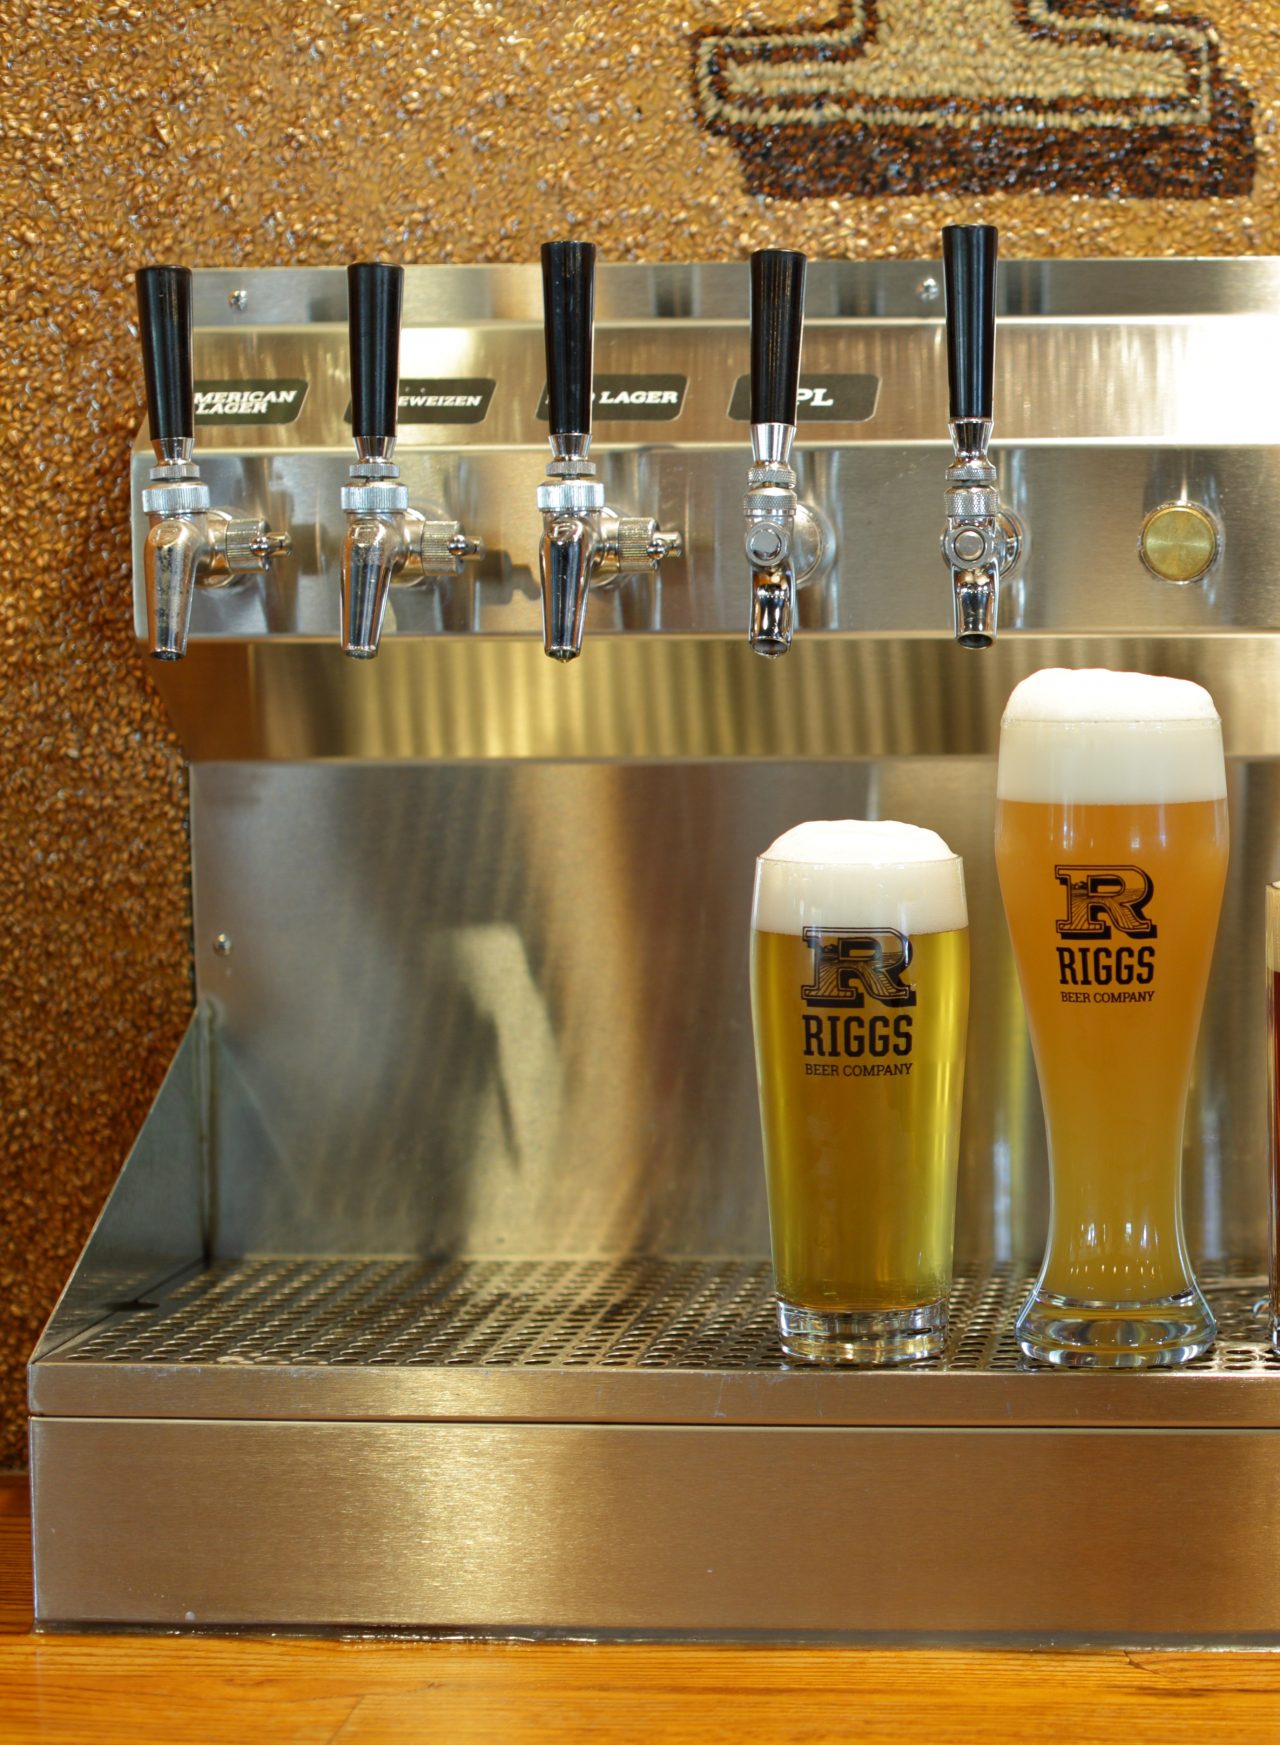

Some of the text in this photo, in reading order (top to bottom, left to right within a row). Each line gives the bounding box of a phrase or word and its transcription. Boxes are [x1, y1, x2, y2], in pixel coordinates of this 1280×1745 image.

[193, 390, 297, 404] MERICAN
[397, 395, 482, 407] EWEIZEN
[599, 391, 678, 404] LAGER
[796, 388, 834, 406] PL
[195, 402, 268, 415] LAGER
[1056, 946, 1155, 985] RIGGS
[1060, 990, 1155, 1003] BEER COMPANY
[802, 1014, 913, 1057] RIGGS
[805, 1062, 913, 1077] BEER COMPANY
